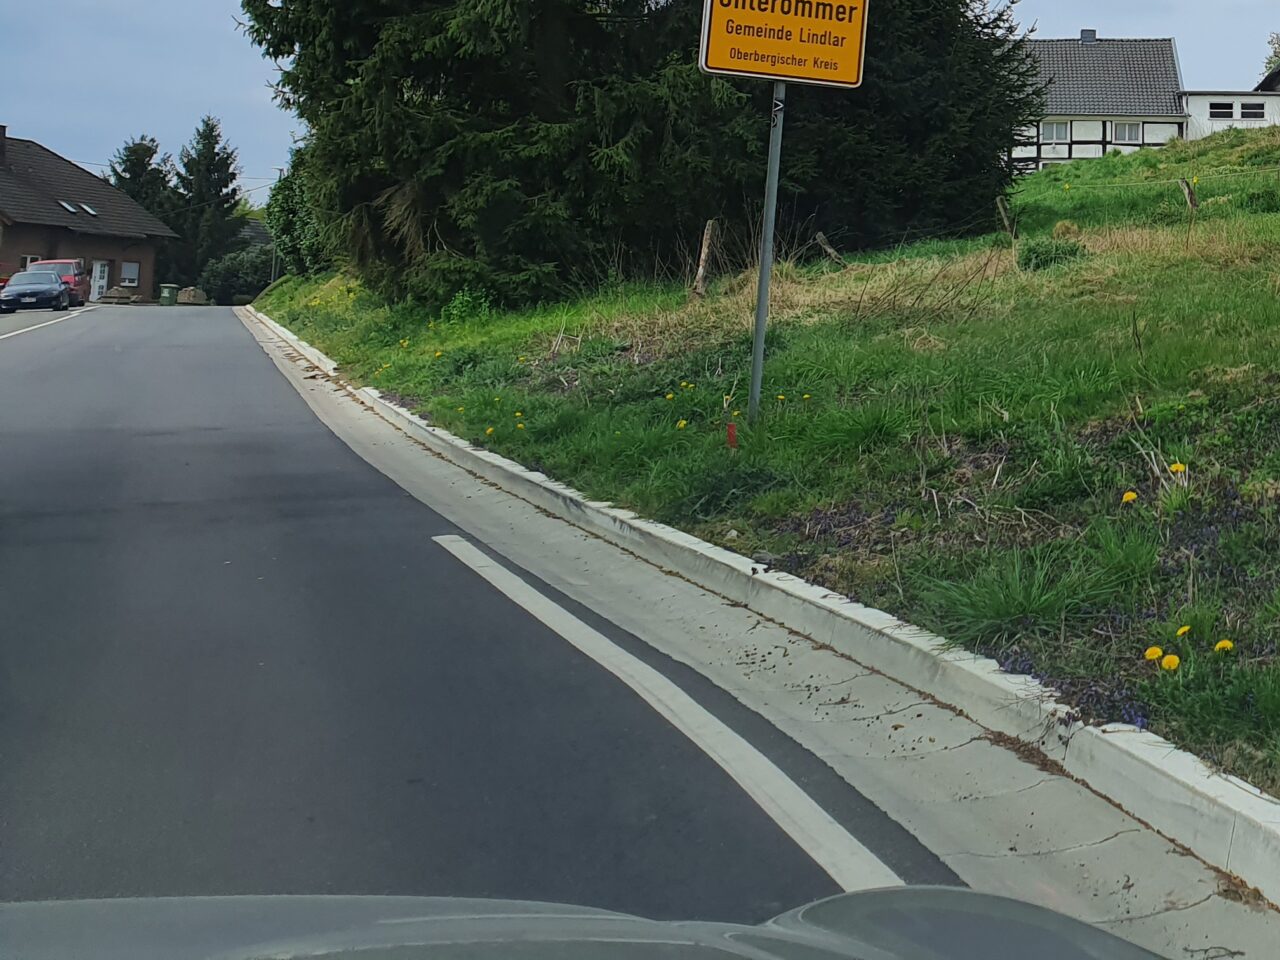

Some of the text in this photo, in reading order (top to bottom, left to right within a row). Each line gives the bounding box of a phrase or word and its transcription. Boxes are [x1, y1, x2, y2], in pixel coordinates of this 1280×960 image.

[726, 19, 847, 47] Gemeinde Lindlar
[729, 47, 839, 71] Oberbergischer Kreis
